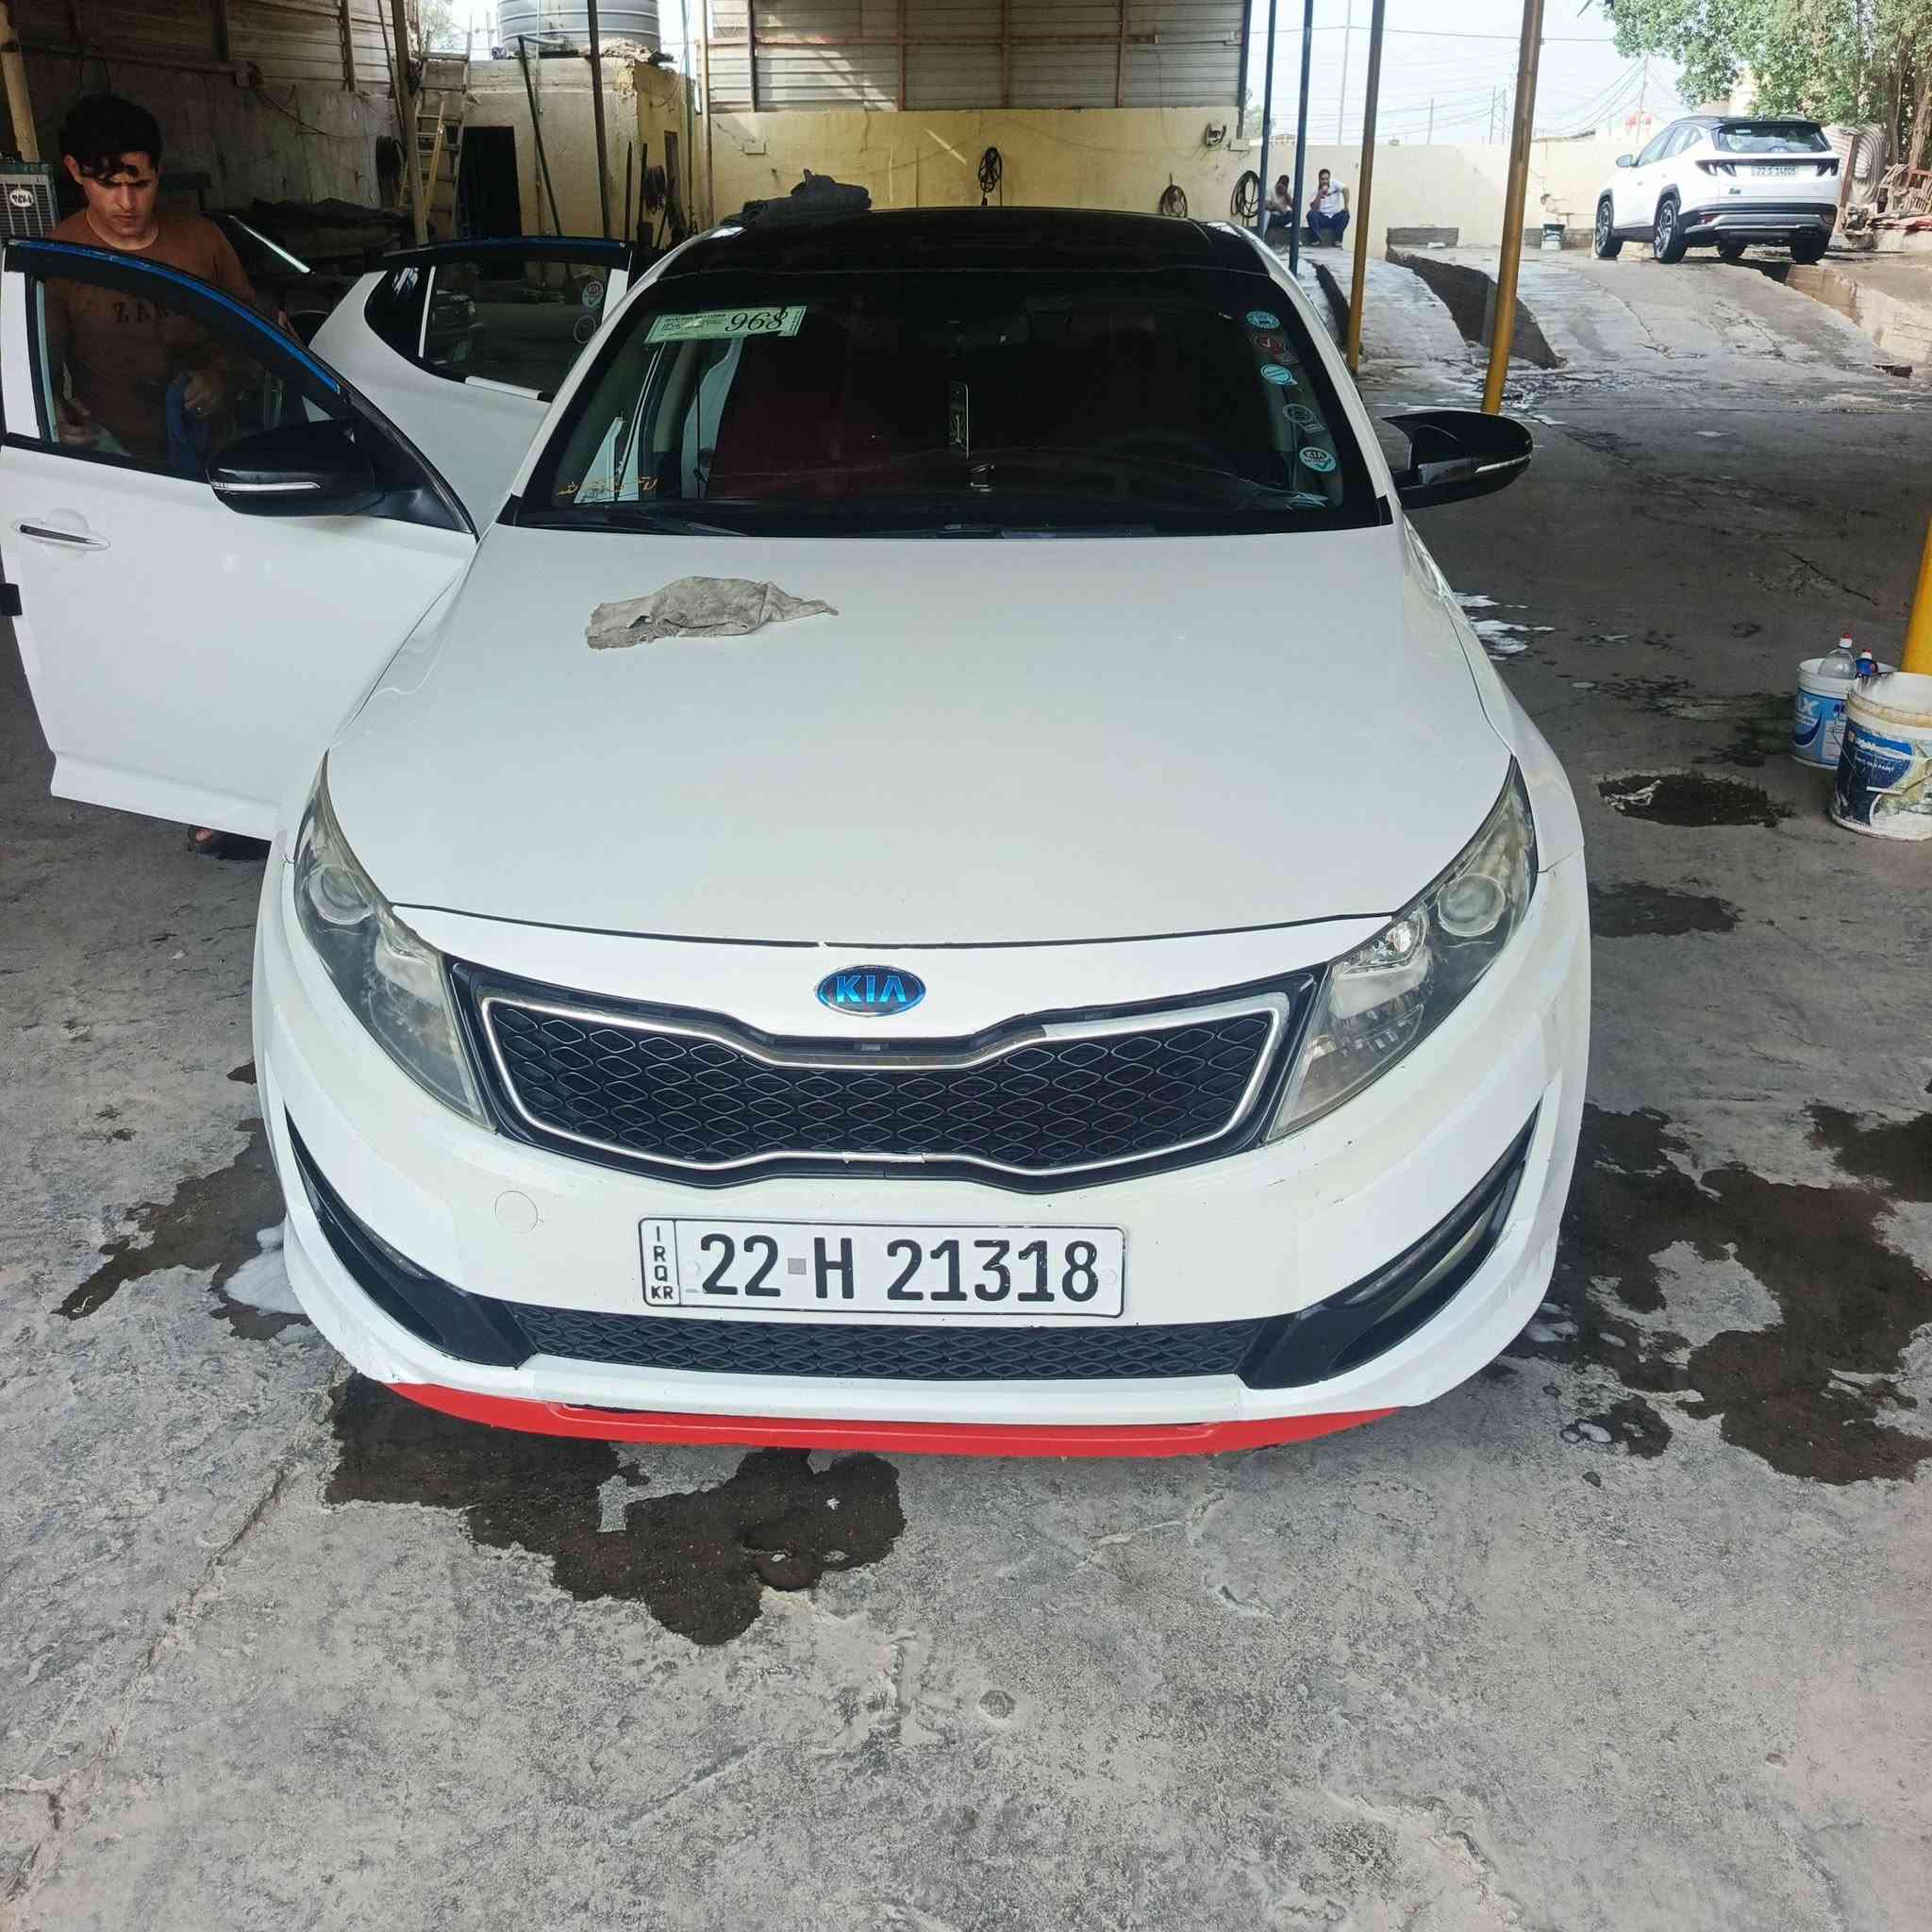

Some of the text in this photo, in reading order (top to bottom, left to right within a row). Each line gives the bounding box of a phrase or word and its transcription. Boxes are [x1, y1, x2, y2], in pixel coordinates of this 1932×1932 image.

[724, 311, 789, 332] 968
[836, 974, 907, 1003] KIA
[700, 1233, 1099, 1303] 22 H 21318
[651, 1285, 674, 1300] KR
